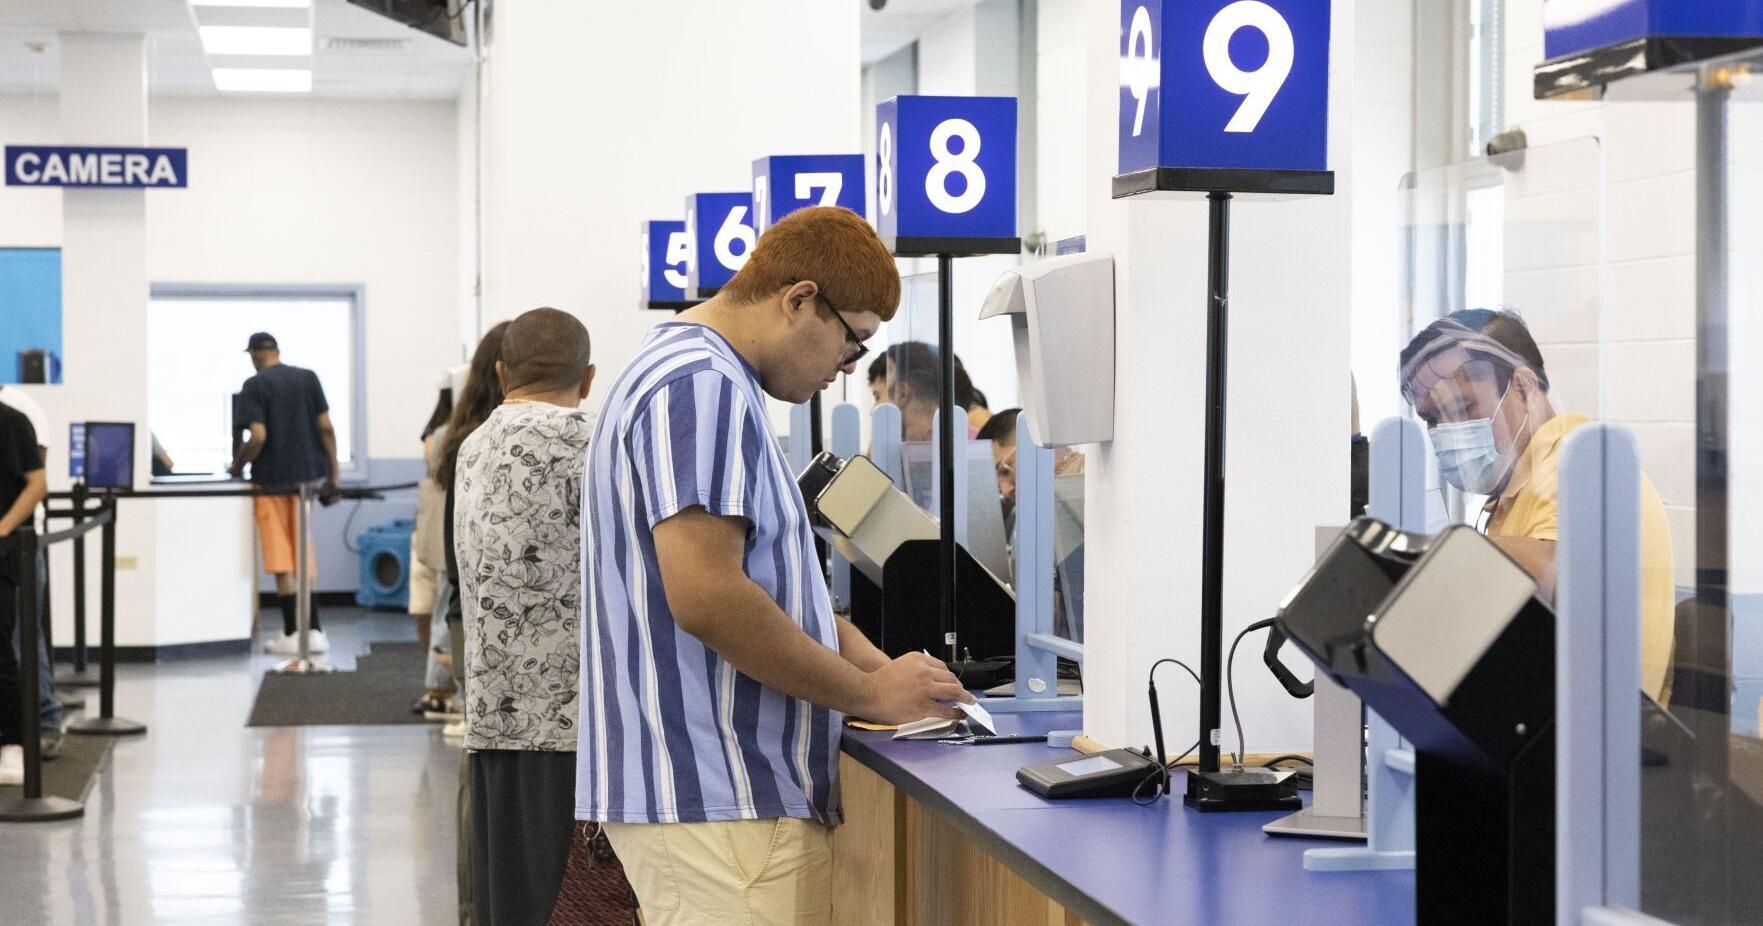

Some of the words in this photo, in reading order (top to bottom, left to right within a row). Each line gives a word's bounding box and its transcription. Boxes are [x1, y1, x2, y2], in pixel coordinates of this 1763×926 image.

[1128, 6, 1152, 137] 9
[1203, 0, 1294, 133] 9
[15, 152, 178, 185] CAMERA
[794, 172, 843, 207] 7
[879, 122, 892, 216] 8
[925, 118, 986, 214] 8
[664, 231, 688, 289] 5
[714, 205, 756, 272] 6
